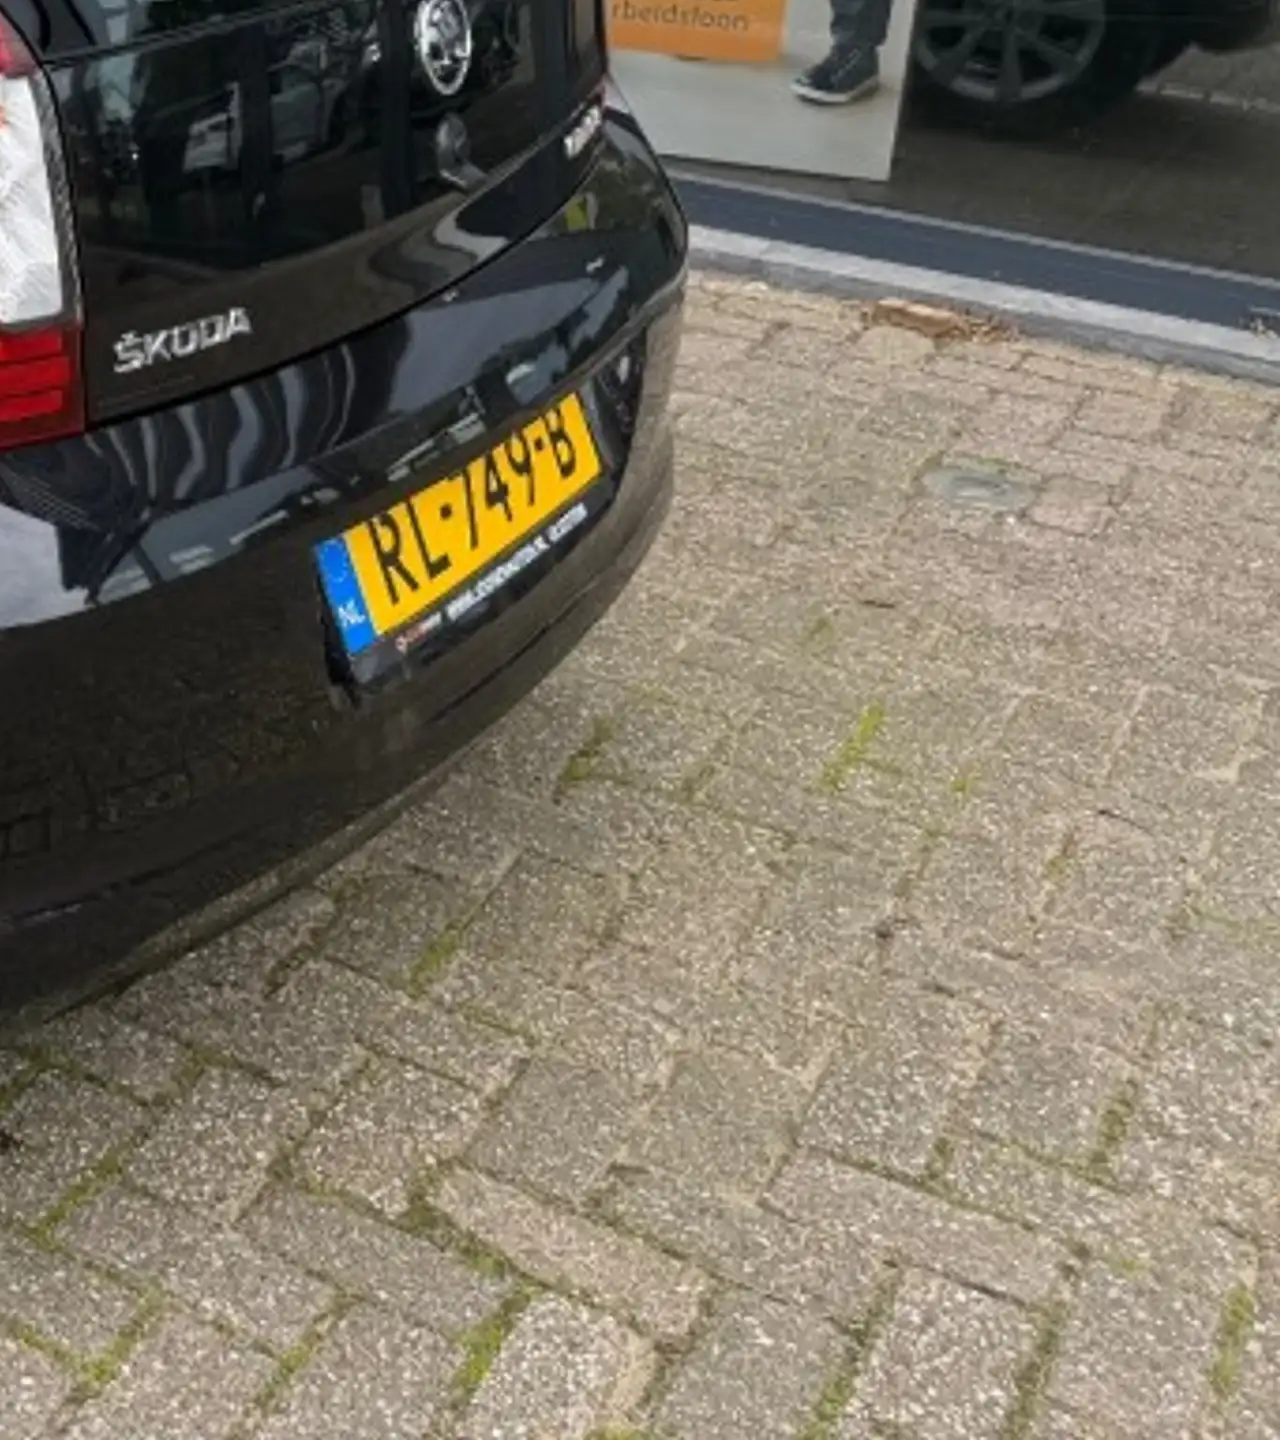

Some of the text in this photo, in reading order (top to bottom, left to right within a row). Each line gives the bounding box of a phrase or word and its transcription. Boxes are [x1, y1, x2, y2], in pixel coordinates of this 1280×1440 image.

[612, 0, 749, 32] rbeidsloon
[112, 307, 252, 373] ŠKODA
[366, 406, 578, 606] RL-749-B
